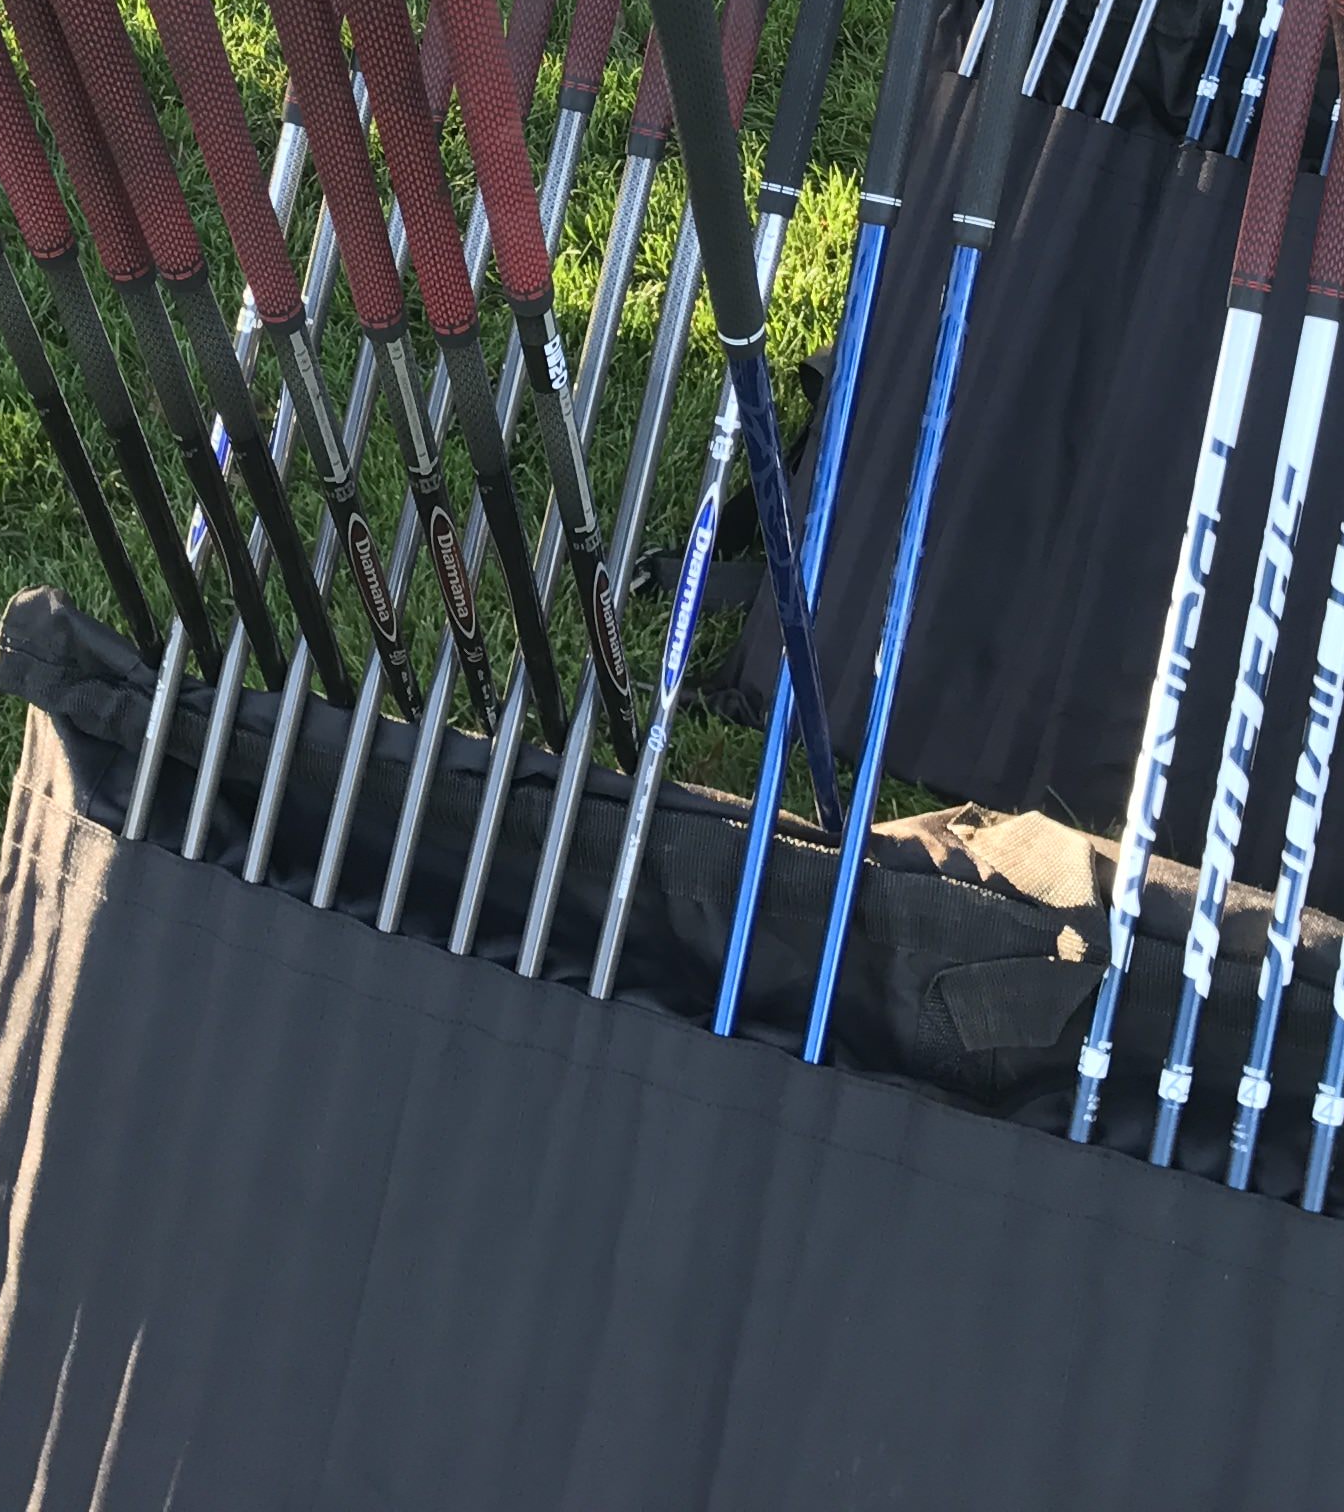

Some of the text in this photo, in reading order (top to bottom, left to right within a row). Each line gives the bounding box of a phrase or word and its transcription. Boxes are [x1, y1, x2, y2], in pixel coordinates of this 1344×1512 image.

[543, 334, 568, 390] DEMO
[355, 536, 391, 624] Diamana
[436, 529, 470, 620] Diamana
[667, 526, 713, 672] Diamana
[599, 587, 626, 678] Diamana
